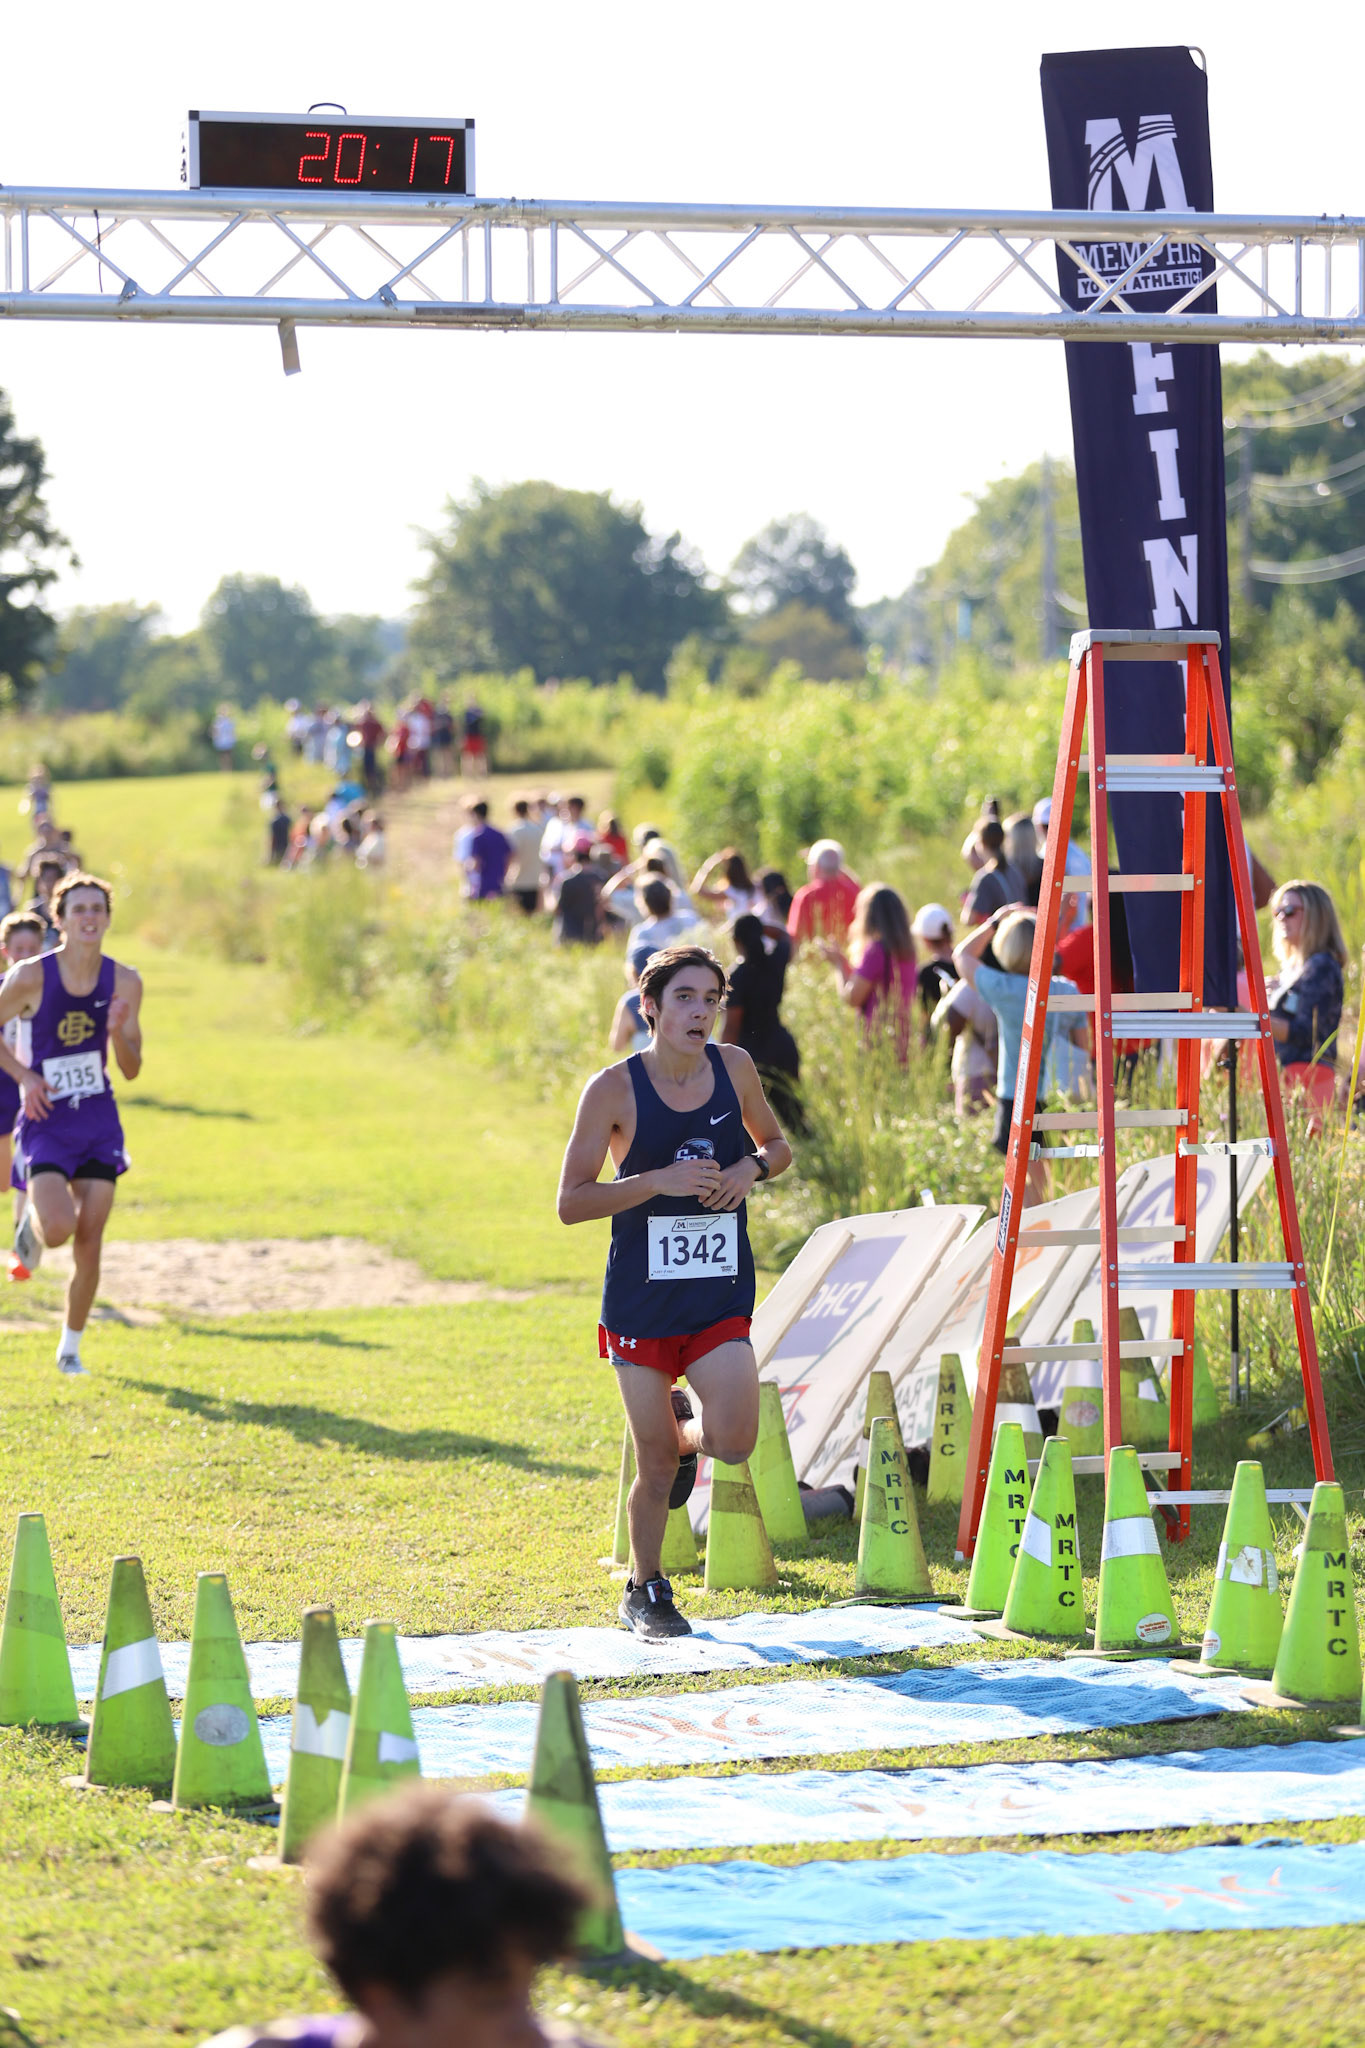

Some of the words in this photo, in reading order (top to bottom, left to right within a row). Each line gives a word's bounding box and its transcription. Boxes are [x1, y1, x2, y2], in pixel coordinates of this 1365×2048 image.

[298, 131, 455, 185] 20:17
[52, 1065, 96, 1091] 2135
[659, 1233, 727, 1266] 1342
[939, 1382, 956, 1456] MRTC
[881, 1450, 909, 1535] MRTC
[1055, 1513, 1076, 1607] MRTC
[1324, 1552, 1348, 1656] MRTC
